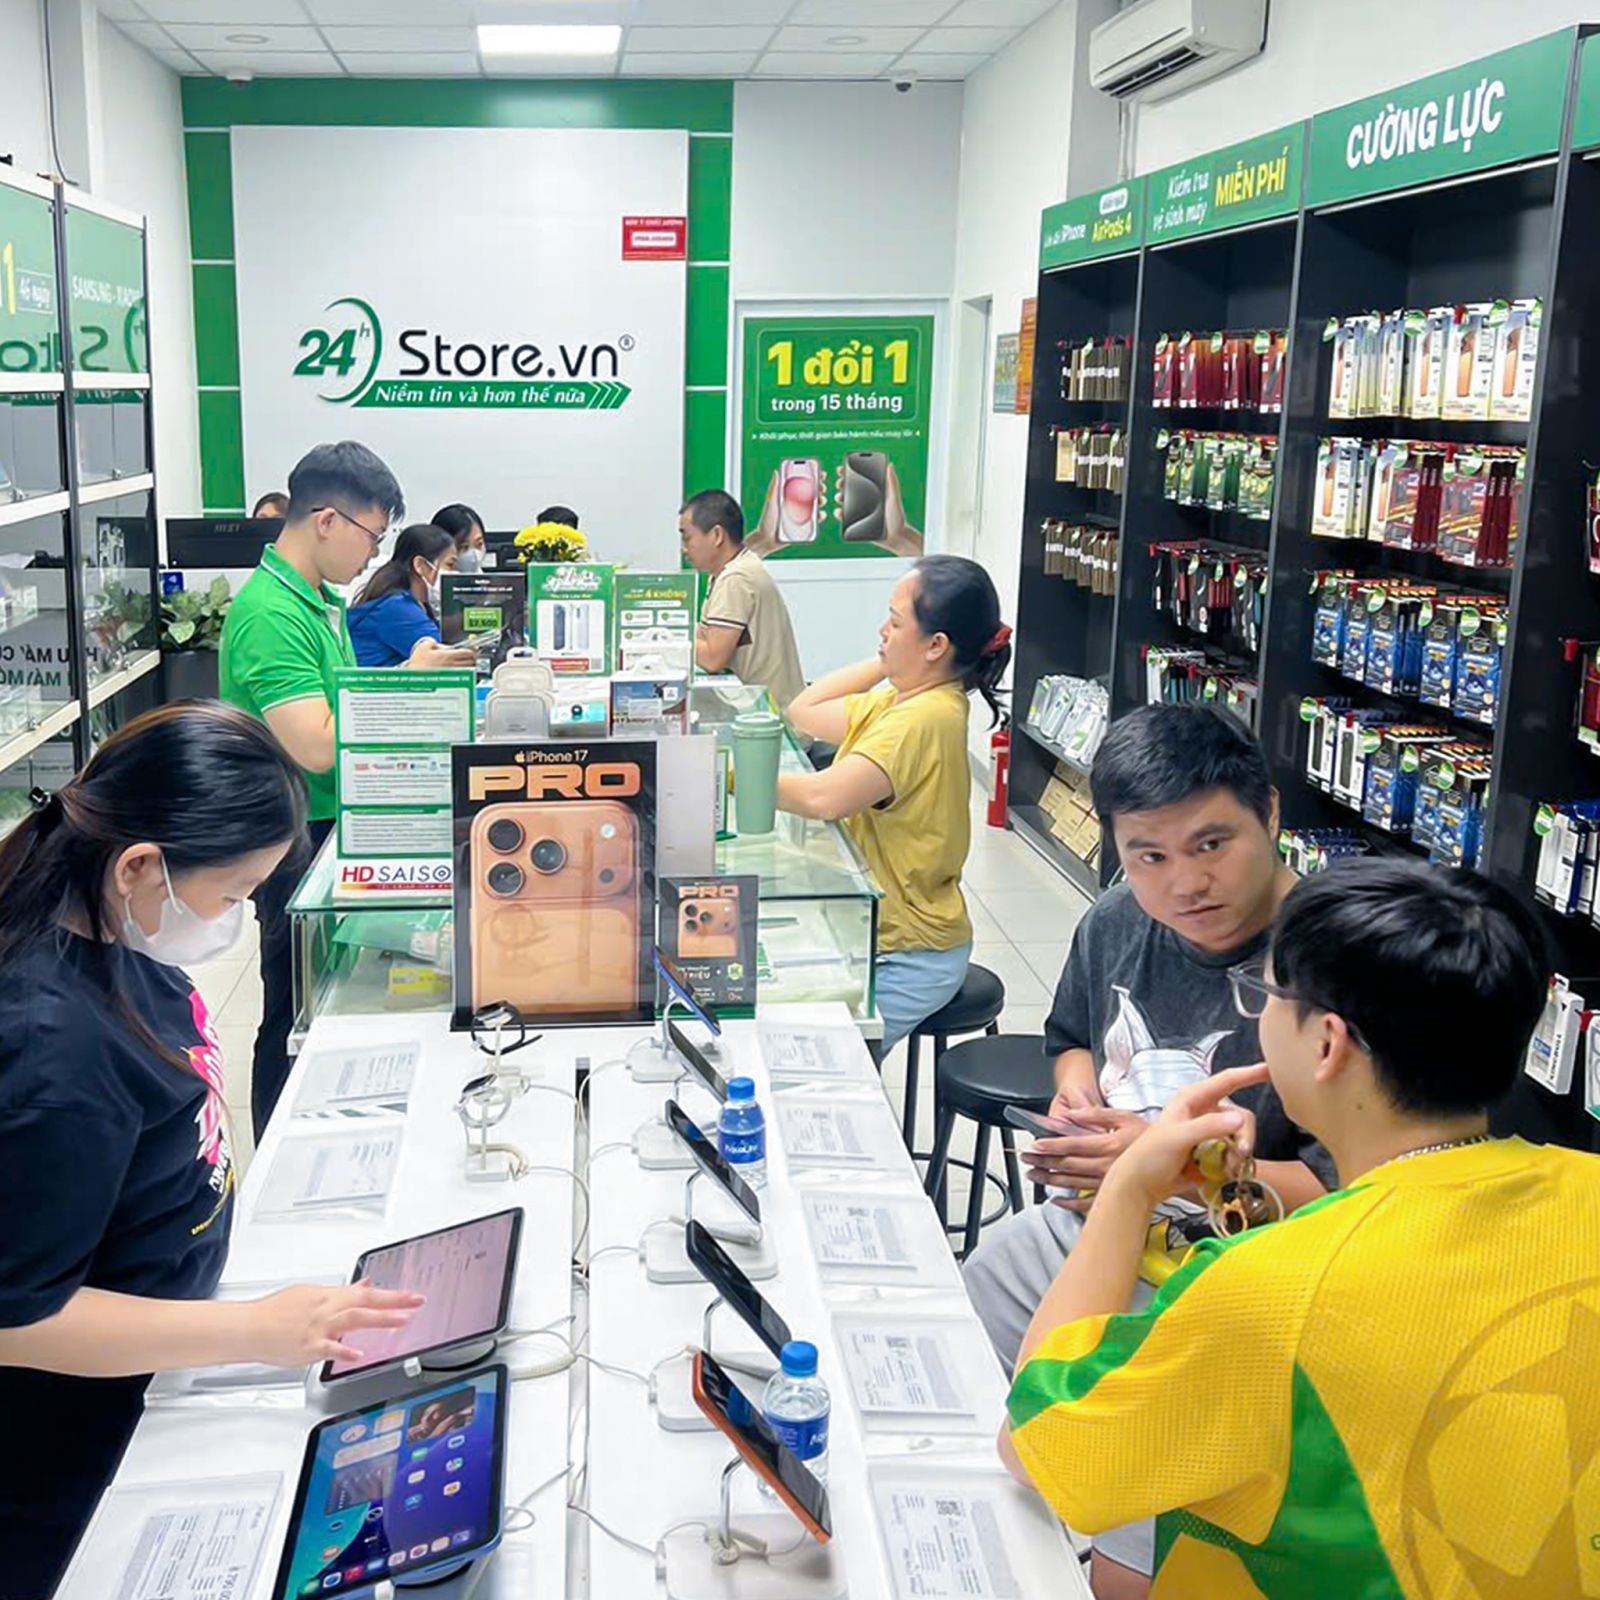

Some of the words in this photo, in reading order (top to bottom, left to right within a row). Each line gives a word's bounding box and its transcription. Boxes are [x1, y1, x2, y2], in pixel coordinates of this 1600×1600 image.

[1346, 103, 1439, 169] CƯỜNG
[1443, 78, 1505, 153] LỰC
[1215, 160, 1255, 207] MIỄN
[1256, 146, 1288, 197] PHÍ
[1091, 216, 1124, 243] AirPods
[768, 341, 793, 385] 1
[803, 340, 874, 385] đổi
[885, 340, 909, 384] 1
[376, 383, 423, 402] Niềm
[430, 386, 452, 402] tin
[459, 386, 478, 402] và
[484, 385, 515, 402] hơn
[522, 384, 553, 402] thế
[555, 387, 586, 403] nữa
[771, 397, 816, 414] trong
[820, 394, 841, 410] 15
[846, 392, 903, 414] tháng
[526, 751, 573, 763] iPhone
[574, 750, 588, 762] 17
[469, 763, 640, 800] PRO
[342, 866, 374, 882] HD
[679, 885, 739, 898] PRO
